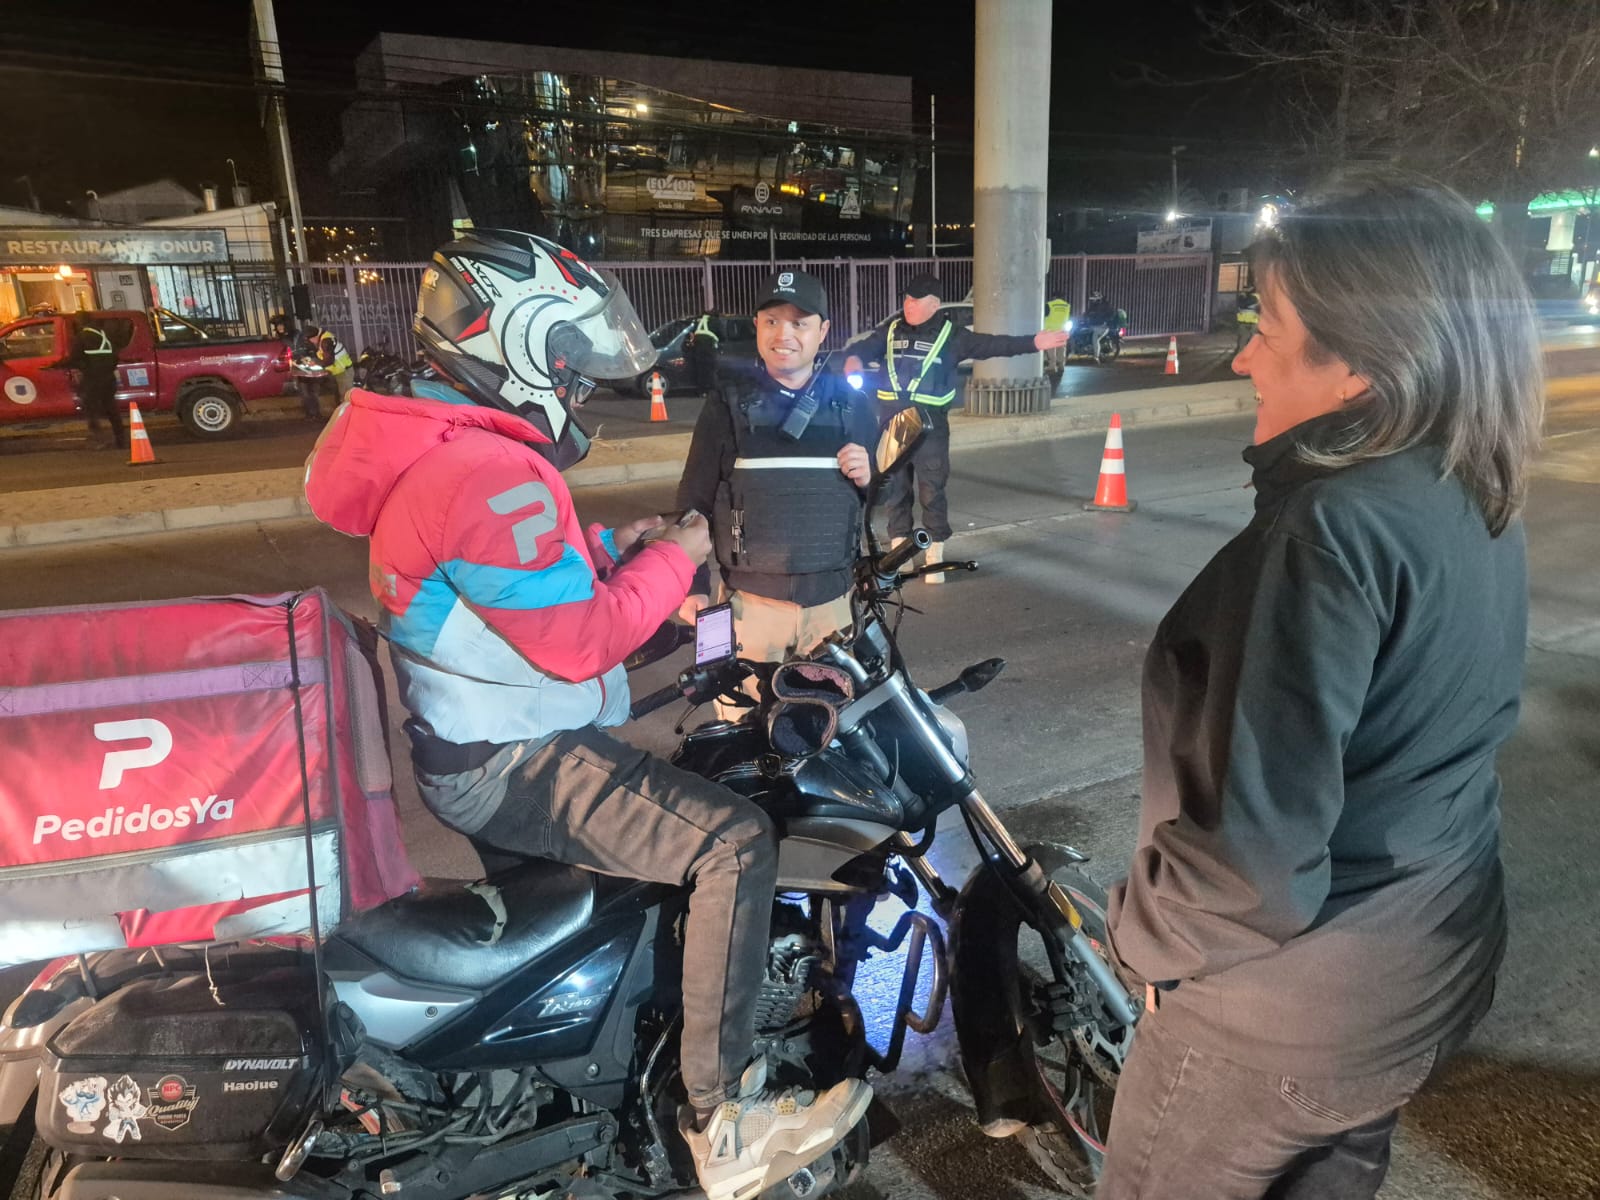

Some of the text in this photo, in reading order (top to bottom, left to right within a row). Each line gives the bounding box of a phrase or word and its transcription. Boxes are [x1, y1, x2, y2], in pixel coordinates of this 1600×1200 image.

[641, 228, 660, 238] TRES
[662, 229, 702, 239] EMPRESAS
[704, 230, 720, 240] QUE
[721, 231, 731, 240] SE
[732, 231, 753, 240] UNEN
[754, 232, 768, 240] POR
[780, 232, 817, 241] SEGURIDAD
[818, 233, 827, 241] DE
[828, 233, 839, 241] LAS
[840, 233, 872, 242] PERSONAS
[161, 240, 215, 254] ONUR
[32, 795, 234, 844] PedidosYa
[225, 1058, 298, 1071] DYNAVOLT
[147, 1097, 200, 1117] Quality
